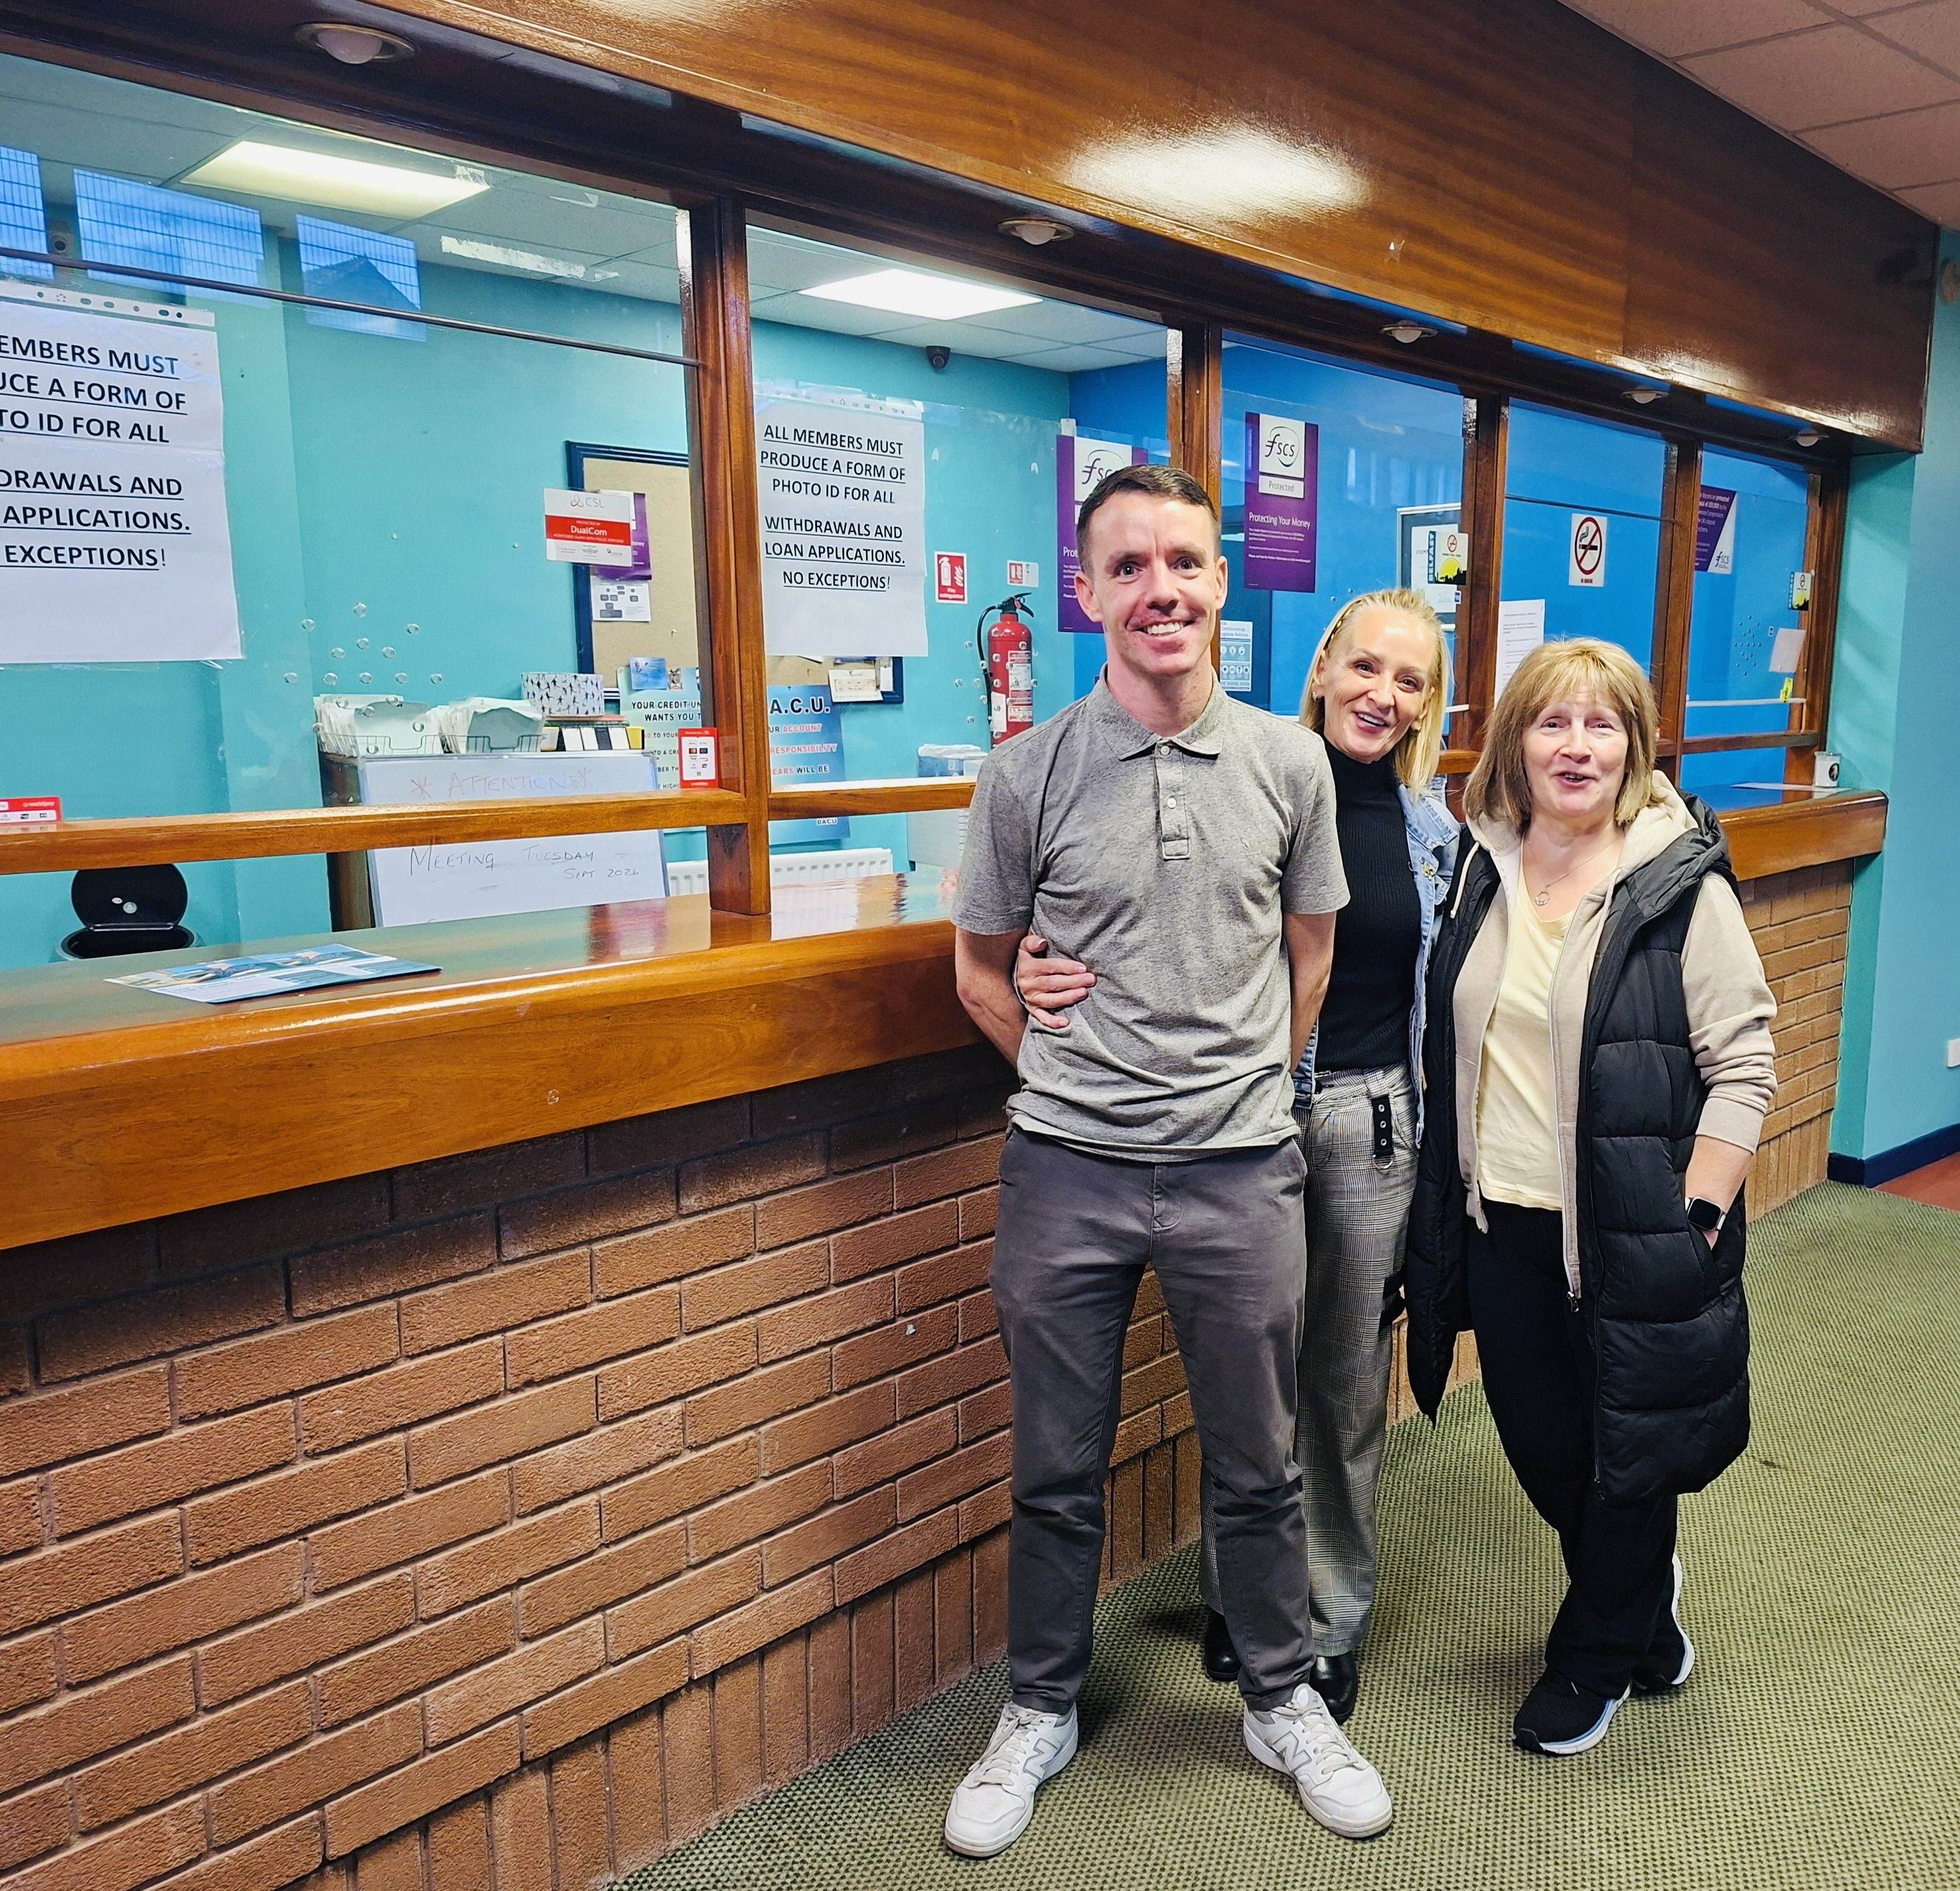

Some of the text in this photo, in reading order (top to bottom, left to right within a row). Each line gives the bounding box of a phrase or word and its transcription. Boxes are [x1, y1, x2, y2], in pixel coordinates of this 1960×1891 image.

[109, 350, 178, 374] MUST
[48, 378, 66, 397] A
[74, 381, 147, 407] FORM
[156, 391, 185, 410] OF
[38, 413, 64, 432] ID
[72, 417, 121, 438] FOR
[129, 423, 170, 442] ALL
[764, 424, 903, 455] ALL MEMBERS MUST
[761, 451, 905, 480] PRODUCE A FORM OF
[130, 477, 182, 495] AND
[773, 478, 895, 504] PHOTO ID FOR ALL
[1268, 480, 1294, 492] Protected
[585, 497, 606, 508] CSL
[3, 506, 190, 530] APPLICATIONS.
[765, 516, 902, 538] WITHDRAWALS AND
[1249, 511, 1311, 530] Protecting Your Money
[571, 525, 607, 536] DualCom
[5, 545, 166, 567] EXCEPTIONS!
[765, 542, 905, 564] LOAN APPLICATIONS.
[783, 571, 890, 589] NO EXCEPTIONS!
[783, 724, 821, 732] ACCOUNT
[770, 744, 837, 754] RESPONSIBILITY
[796, 766, 815, 774] WILL
[449, 772, 566, 798] ATTENTION
